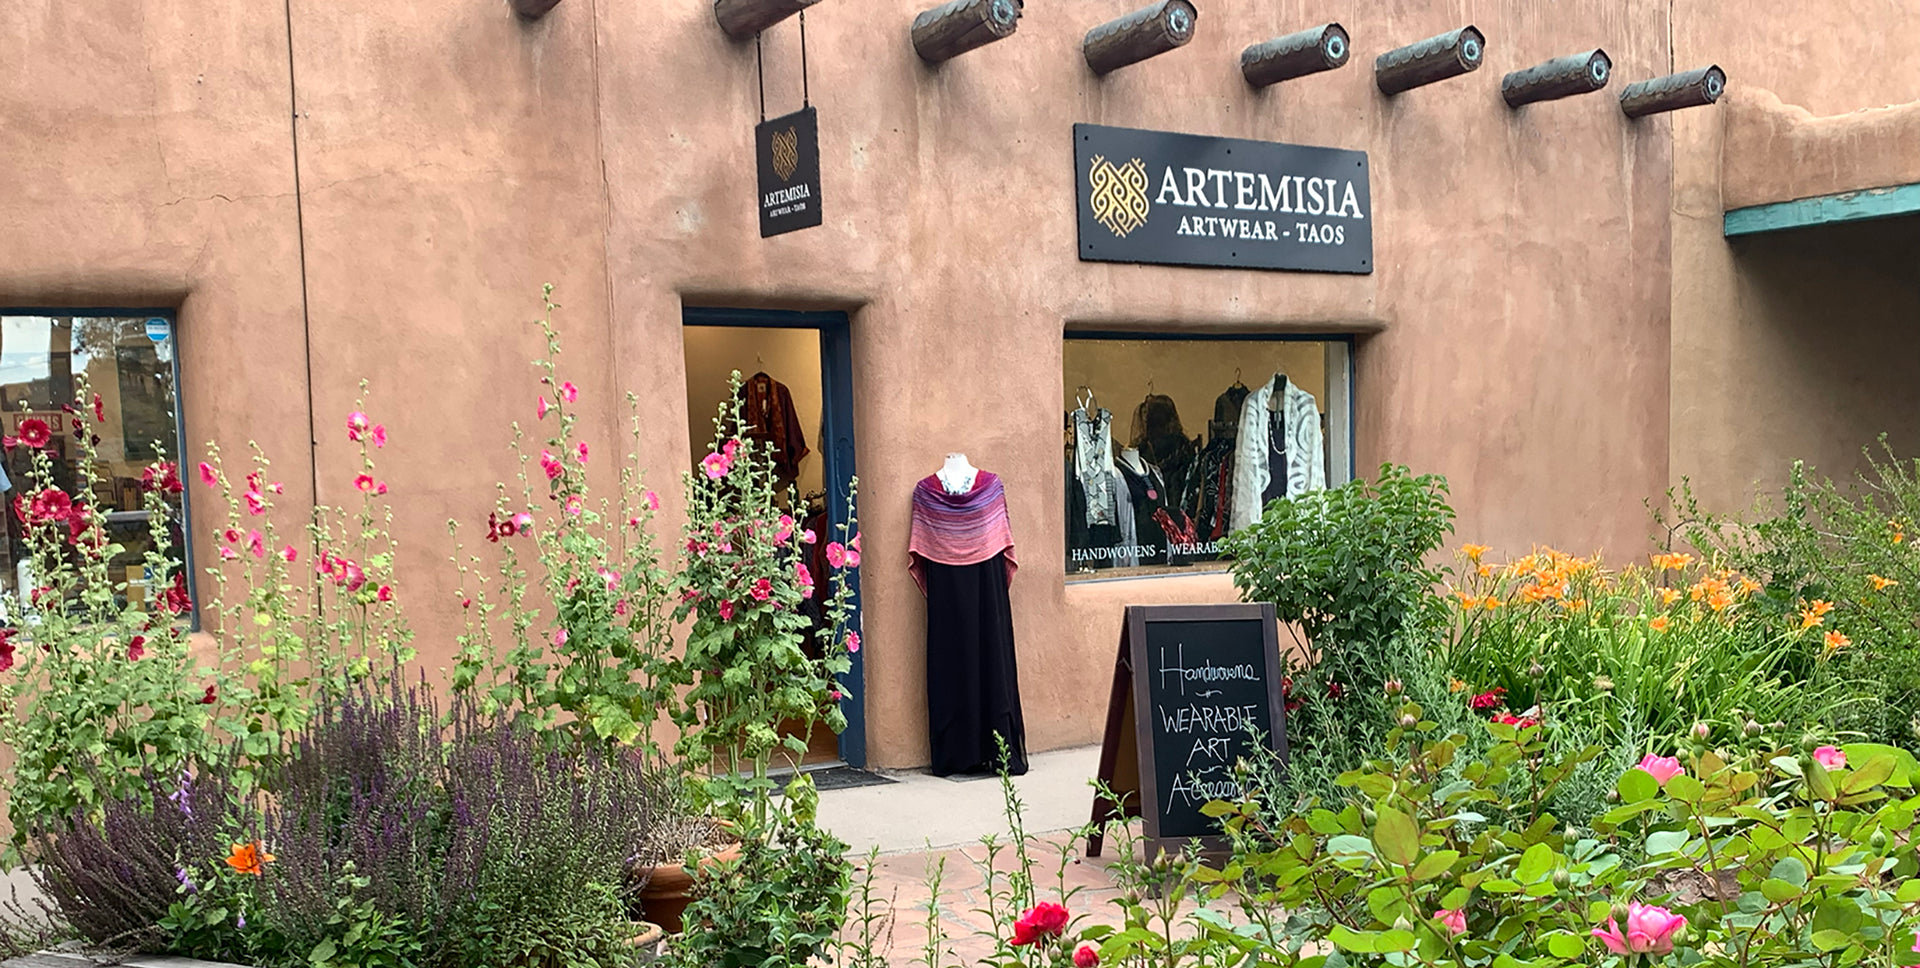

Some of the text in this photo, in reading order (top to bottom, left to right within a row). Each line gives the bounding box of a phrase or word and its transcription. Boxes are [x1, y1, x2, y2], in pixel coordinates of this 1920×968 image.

[764, 183, 811, 208] ARTEMISIA
[1155, 166, 1364, 219] ARTEMISIA
[1177, 215, 1278, 240] ARTWEAR
[1296, 222, 1345, 245] TAOS
[1072, 544, 1156, 561] HANDWOVENS
[1171, 541, 1229, 555] WEARAB
[1159, 643, 1260, 696] Handwovens
[1186, 738, 1231, 767] ART
